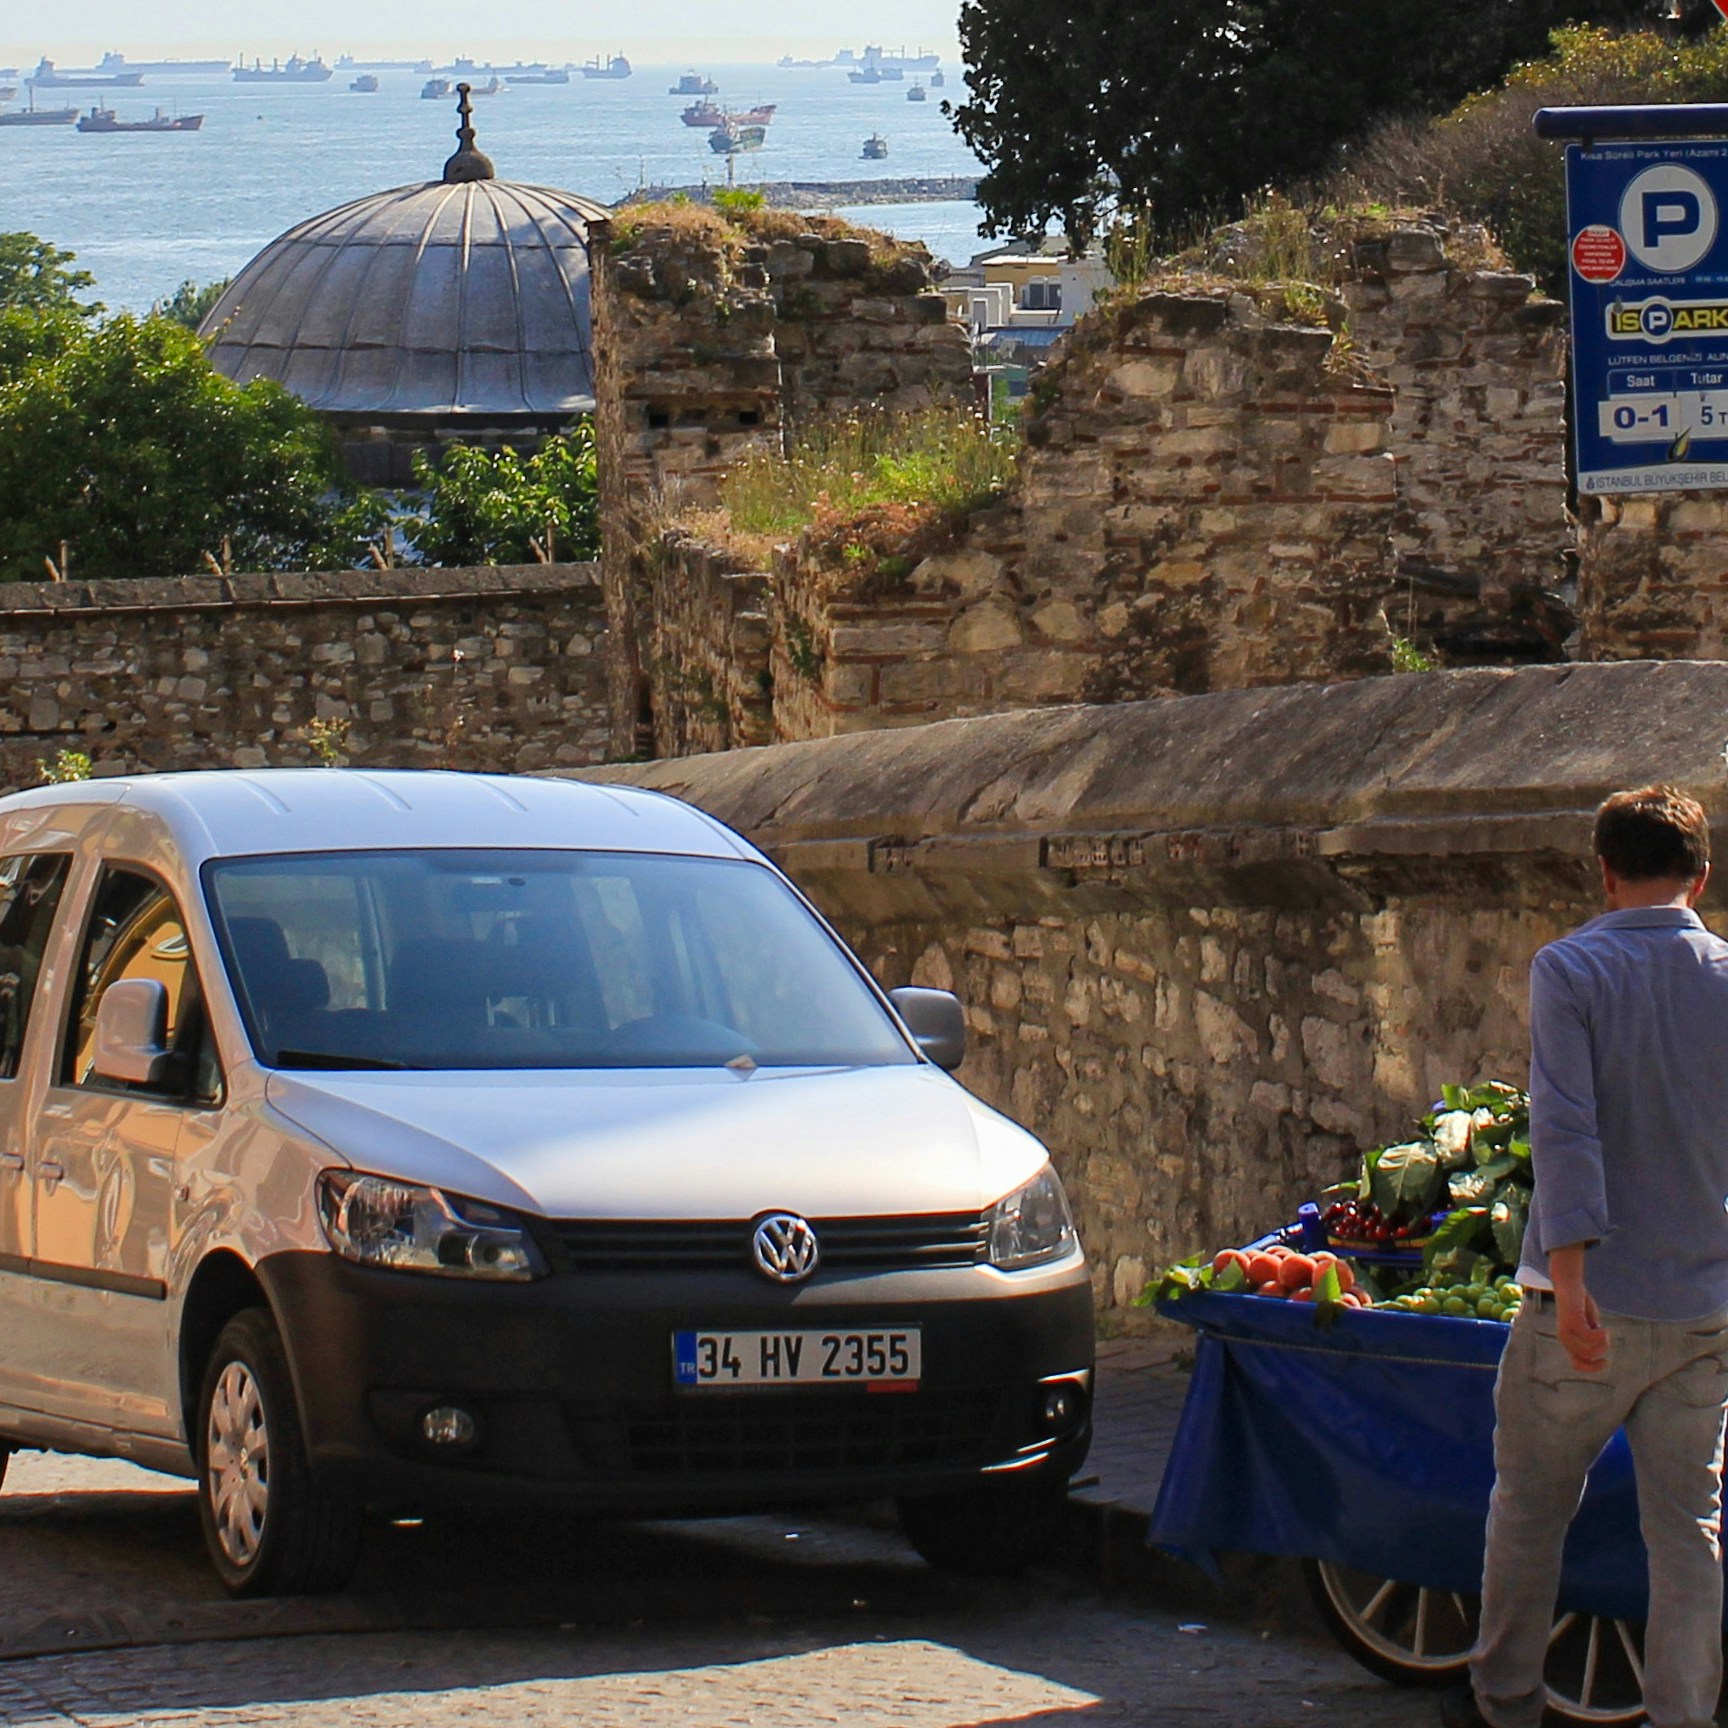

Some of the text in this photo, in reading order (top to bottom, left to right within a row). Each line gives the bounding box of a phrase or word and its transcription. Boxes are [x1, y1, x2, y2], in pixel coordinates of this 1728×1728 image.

[1642, 191, 1700, 248] P
[1626, 375, 1656, 387] Saat
[1690, 372, 1724, 385] Tutar
[1613, 404, 1669, 429] 0-1
[1700, 406, 1713, 425] 5
[697, 1334, 909, 1378] 34 HV 2355
[679, 1363, 696, 1374] TR
